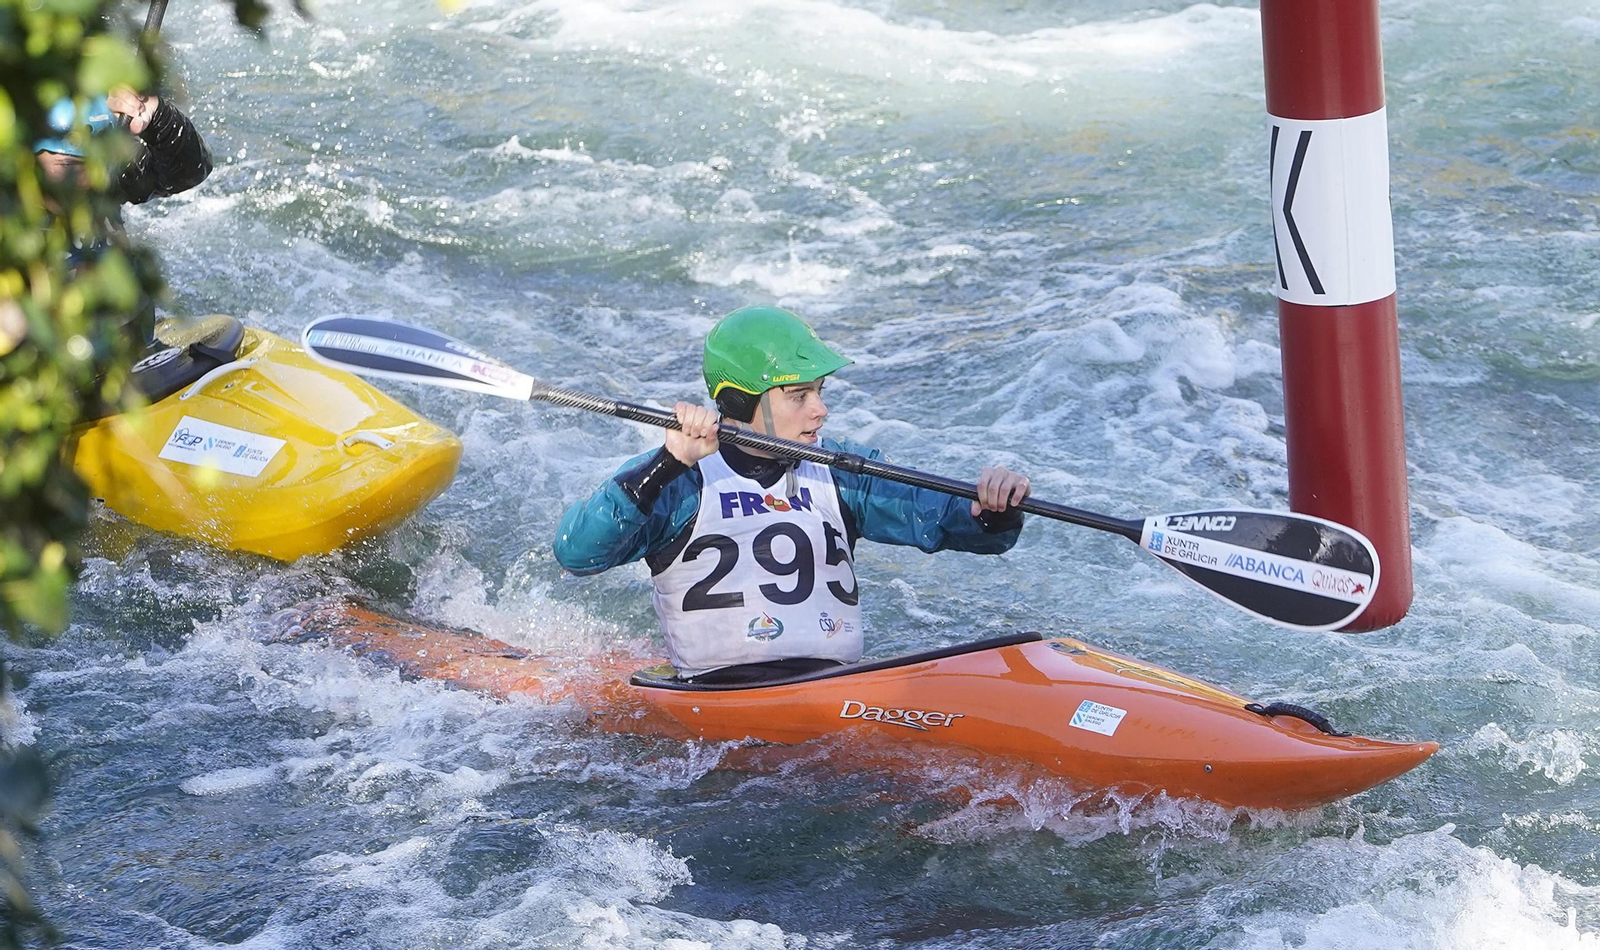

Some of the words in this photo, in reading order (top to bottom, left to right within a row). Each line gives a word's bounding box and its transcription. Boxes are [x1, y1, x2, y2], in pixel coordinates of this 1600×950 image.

[1166, 535, 1200, 551] XUNTA
[1164, 545, 1177, 556] DE
[1178, 549, 1218, 566] GALICIA
[682, 521, 859, 612] 295
[819, 618, 836, 631] CSD
[839, 700, 965, 732] Dagger
[1093, 704, 1114, 712] XUNTA
